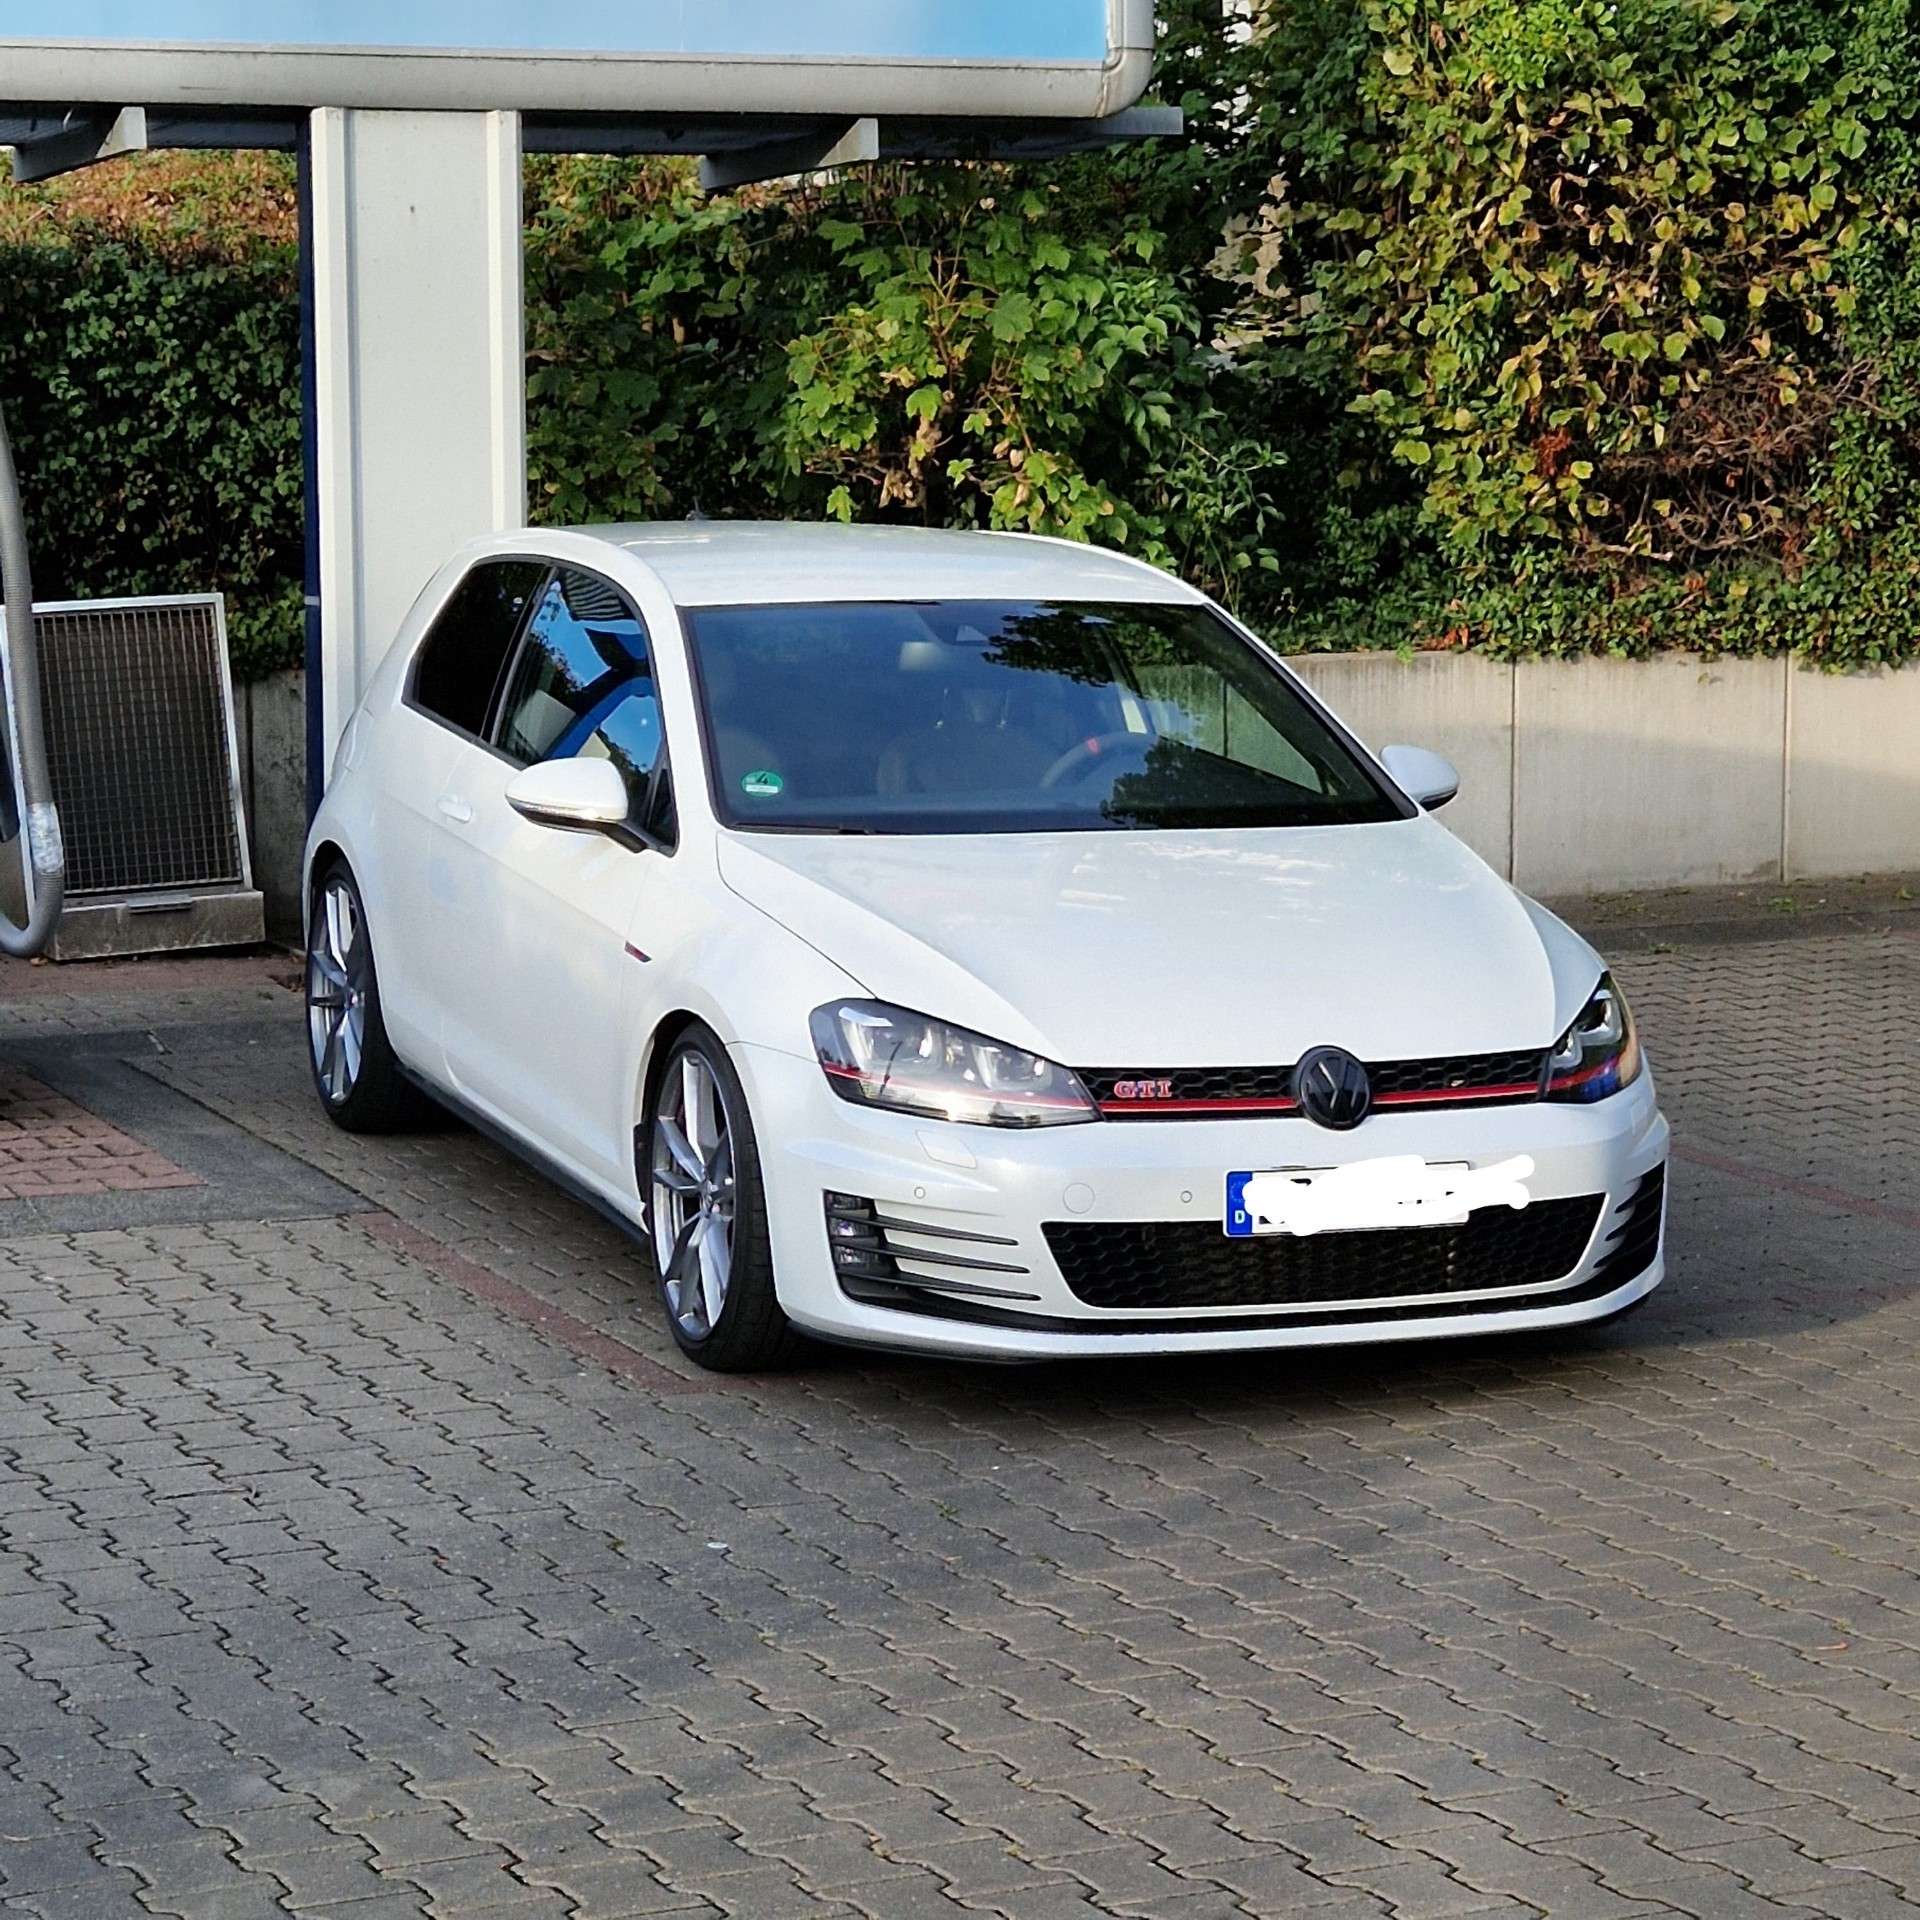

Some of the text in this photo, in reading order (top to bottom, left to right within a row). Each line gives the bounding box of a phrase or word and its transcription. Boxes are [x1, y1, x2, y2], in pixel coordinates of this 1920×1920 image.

[755, 772, 769, 785] 4
[1113, 1080, 1173, 1098] GTI
[1234, 1209, 1246, 1225] D
